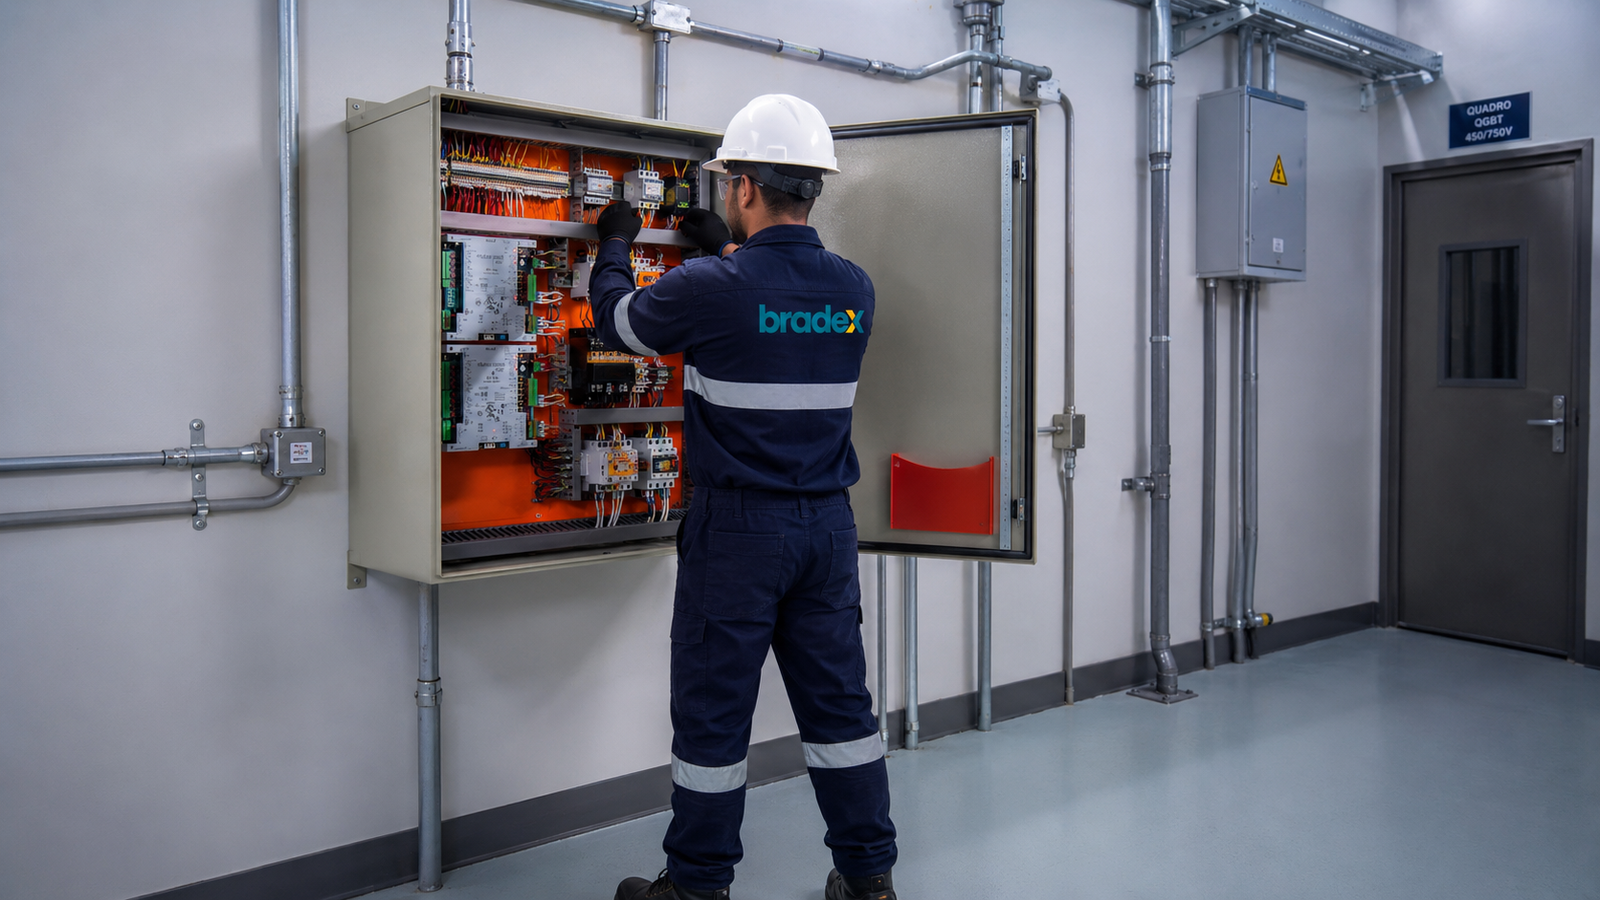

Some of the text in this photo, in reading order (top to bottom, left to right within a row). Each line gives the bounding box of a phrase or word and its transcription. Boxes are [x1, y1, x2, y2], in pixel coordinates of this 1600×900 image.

[1466, 100, 1512, 116] QUADRO
[1474, 114, 1504, 128] QGBT
[1464, 126, 1513, 142] 450/750V
[759, 304, 865, 334] bradex
